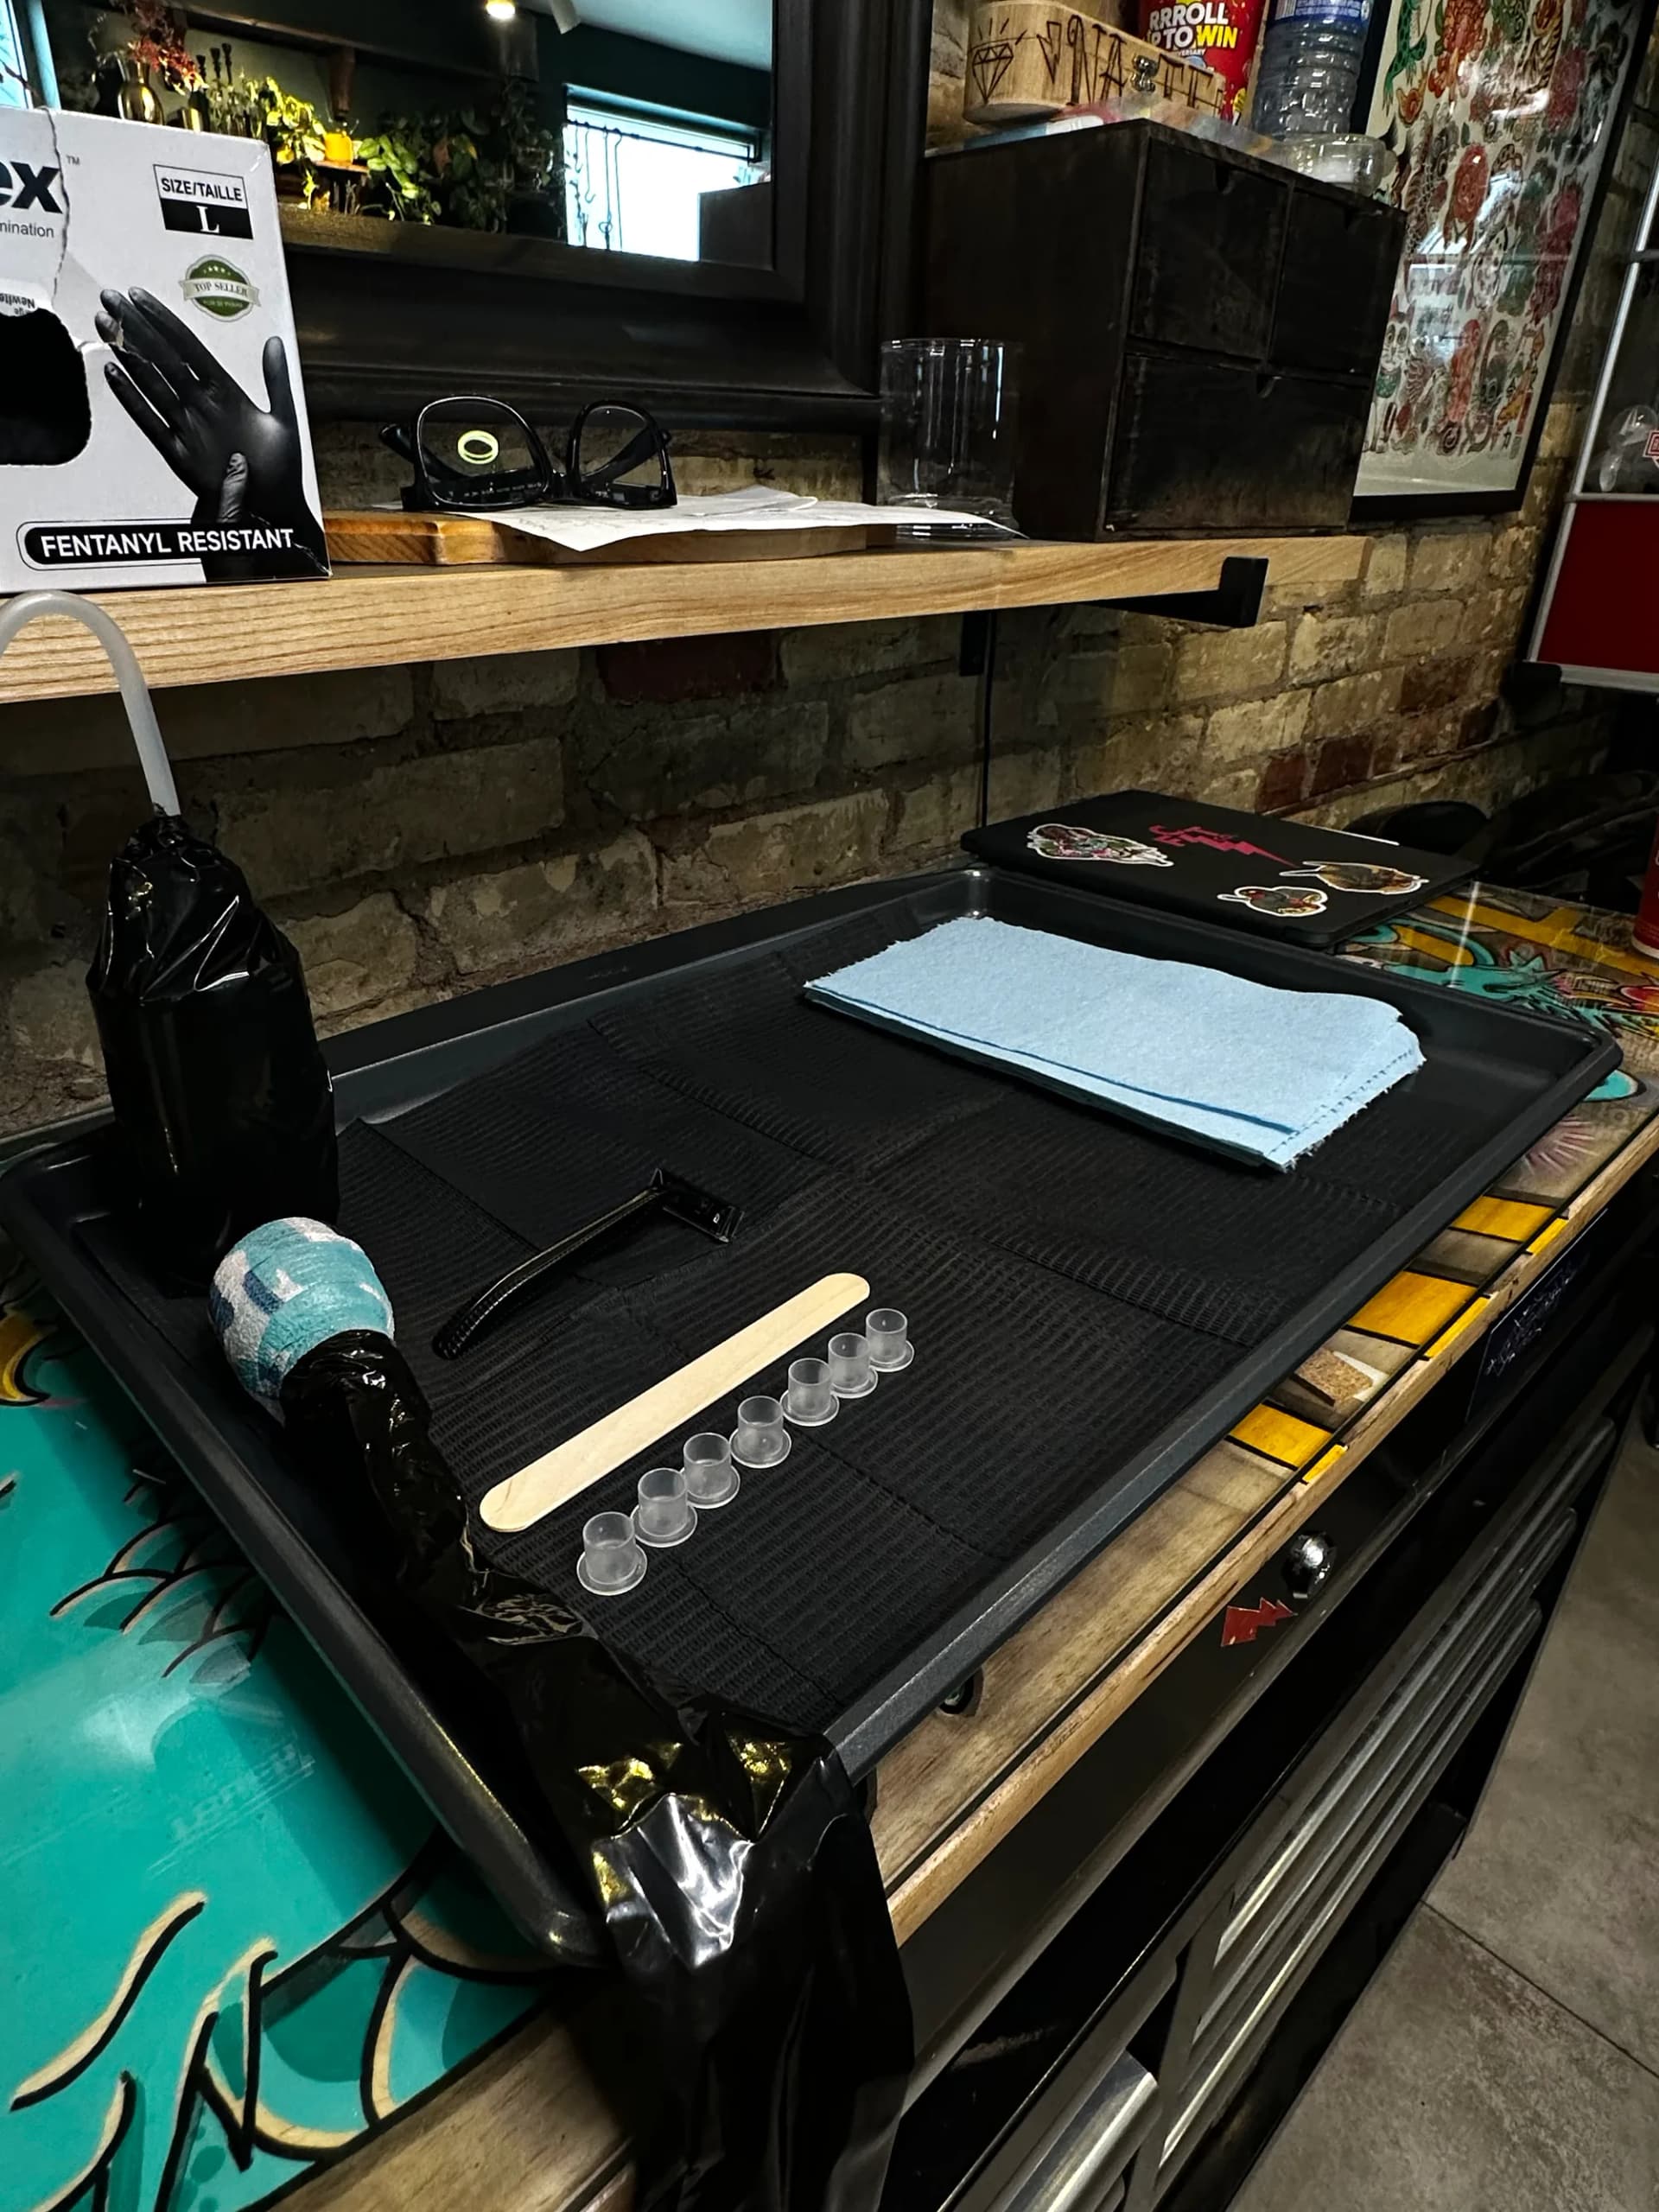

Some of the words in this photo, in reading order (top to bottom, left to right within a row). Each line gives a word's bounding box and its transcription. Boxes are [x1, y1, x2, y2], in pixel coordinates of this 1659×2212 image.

[1149, 3, 1229, 31] RRROLL
[1163, 26, 1193, 49] TO
[1196, 25, 1238, 48] WIN
[161, 177, 243, 202] SIZE/TAILLE
[196, 206, 220, 234] L
[194, 281, 212, 292] TOP
[214, 282, 248, 297] SELLER
[41, 531, 172, 557] FENTANYL
[176, 528, 295, 552] RESISTANT
